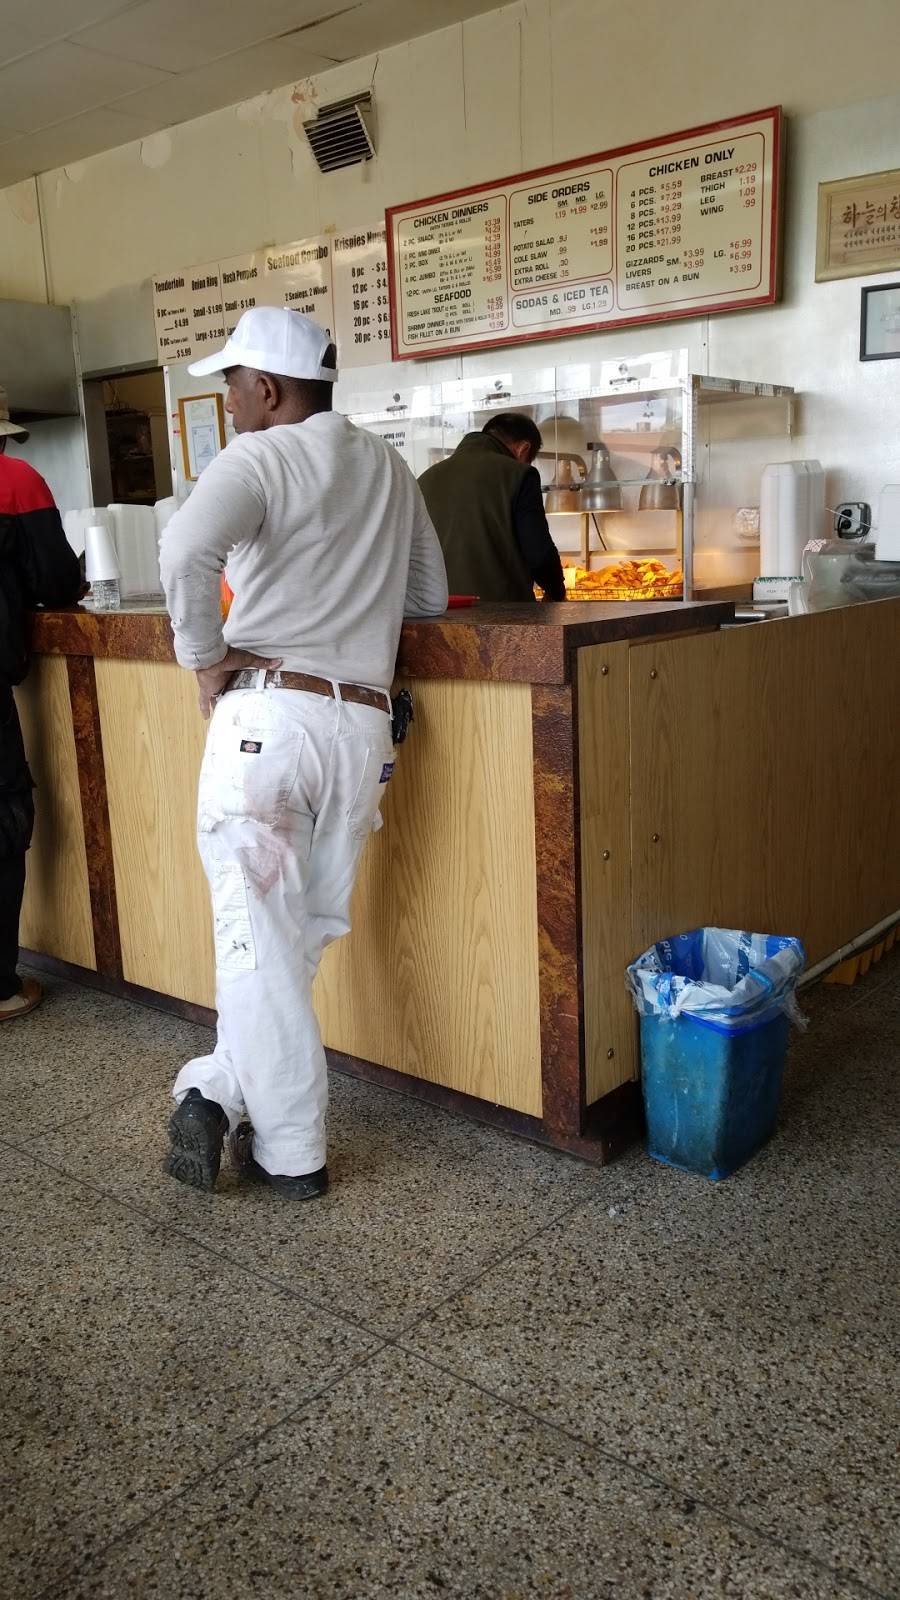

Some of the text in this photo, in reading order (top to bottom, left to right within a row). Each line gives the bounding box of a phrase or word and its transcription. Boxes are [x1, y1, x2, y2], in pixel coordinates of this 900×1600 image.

[649, 148, 735, 177] CHICKEN ONLY
[700, 162, 757, 183] BREAST $2.29
[527, 181, 590, 205] SIDE ORDERS
[631, 190, 636, 198] 4
[639, 186, 656, 197] PCS.
[700, 182, 725, 194] THIGH
[700, 186, 756, 205] LEG 1.09
[639, 198, 656, 208] PCS.
[413, 212, 449, 229] CHICKEN
[451, 202, 489, 219] DINNERS
[631, 212, 636, 220] 8
[639, 209, 656, 218] PCS.
[700, 205, 724, 216] WING
[513, 218, 534, 228] TATERS
[627, 223, 635, 231] 12
[639, 219, 656, 229] PCS.
[627, 233, 635, 242] 16
[639, 230, 656, 239] PCS.
[334, 234, 366, 252] Krispies
[513, 241, 534, 252] POTATO
[535, 237, 554, 247] SALAD
[626, 244, 635, 252] 20
[639, 241, 656, 250] PCS.
[267, 246, 328, 271] Seafood Combo
[513, 255, 528, 264] COLE
[530, 251, 548, 260] SLAW
[626, 255, 664, 268] GIZZARDS
[683, 248, 704, 258] $3.99
[714, 250, 726, 258] LG.
[730, 239, 751, 250] $6.99
[418, 259, 429, 267] BOX
[514, 266, 533, 275] EXTRA
[535, 263, 550, 271] ROLL
[626, 250, 751, 279] LIVERS $3.99 $6.99
[223, 271, 236, 284] Hush
[352, 268, 356, 277] 8
[419, 271, 436, 281] JUMBO
[514, 277, 533, 286] EXTRA
[535, 271, 557, 281] CHEESE
[626, 263, 752, 291] BREAST ON A BUN $3.99
[155, 277, 185, 293] Tenderloin
[191, 276, 218, 291] Onion Ring
[352, 284, 359, 294] 12
[434, 289, 472, 304] SEAFOOD
[516, 285, 608, 310] SODAS & ICED TEA
[224, 301, 237, 312] Small
[353, 301, 359, 310] 16
[193, 307, 206, 318] Small
[354, 317, 362, 327] 20
[407, 323, 426, 332] SHRIMP
[195, 331, 207, 342] Large
[354, 333, 362, 343] 30
[407, 333, 419, 341] FISH
[420, 330, 434, 339] FILLET
[450, 326, 460, 334] BUN
